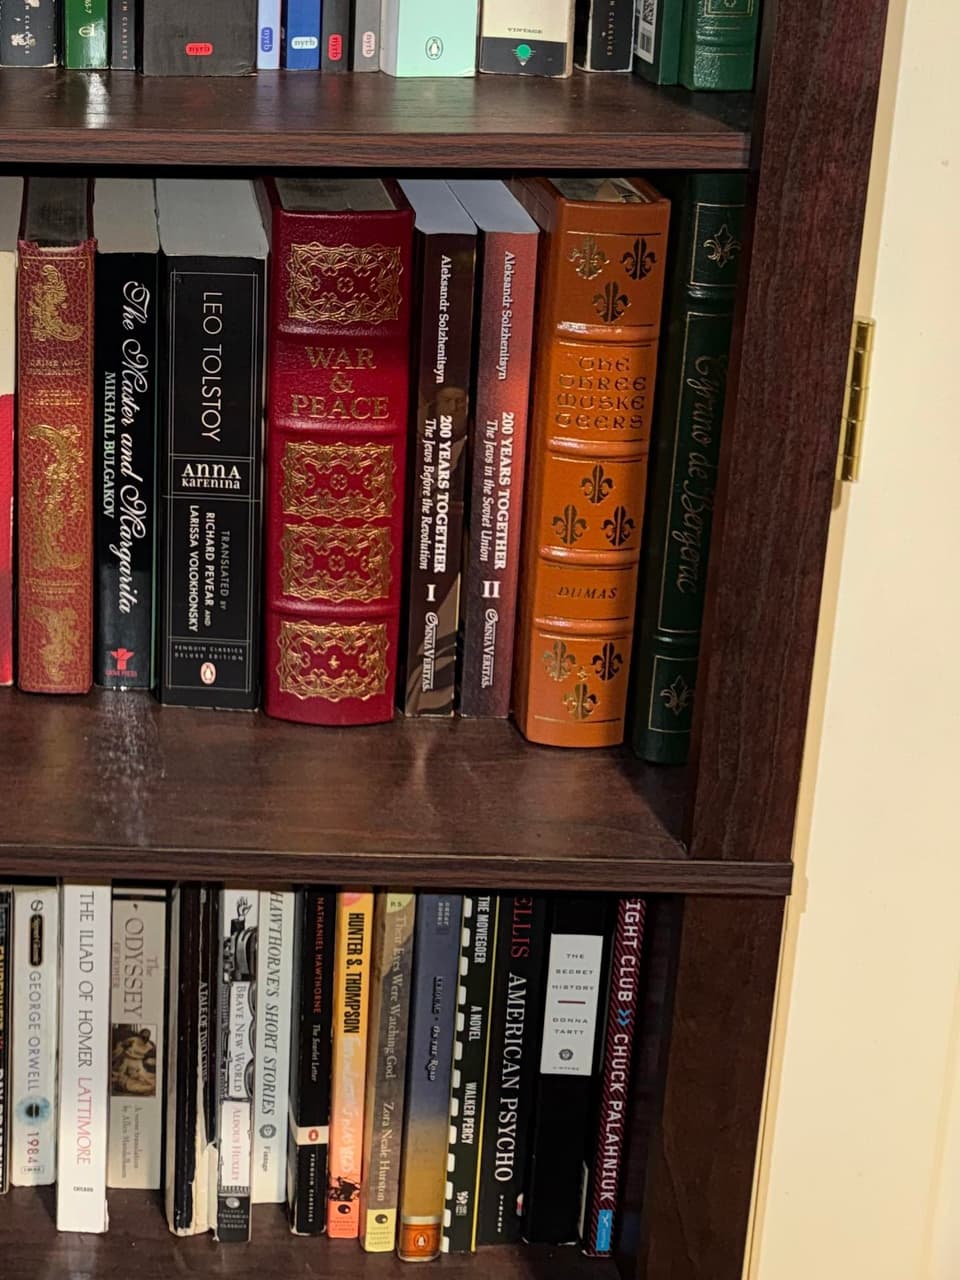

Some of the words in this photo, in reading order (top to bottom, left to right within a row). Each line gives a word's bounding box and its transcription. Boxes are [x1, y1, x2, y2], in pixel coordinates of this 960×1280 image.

[202, 292, 223, 335] LEO
[305, 346, 377, 370] WAR
[201, 344, 222, 442] TOLSTOY
[291, 394, 390, 420] PEACE
[109, 484, 147, 615] Margarita
[205, 512, 216, 561] RICHARD
[558, 586, 619, 600] DUMAS
[347, 912, 365, 956] HUNTER
[123, 917, 144, 1018] ODYSSEY
[346, 959, 362, 970] S.
[617, 955, 637, 1002] CLUB
[28, 972, 41, 1031] GEORGE
[344, 972, 362, 1034] THOMPSON
[28, 1036, 41, 1091] ORWELL
[78, 1010, 94, 1069] HOMER
[77, 1078, 93, 1165] LATTIMORE
[495, 1098, 519, 1182] PSYCHO
[600, 1100, 623, 1201] PALAHNIUK
[377, 1160, 391, 1202] Hurston
